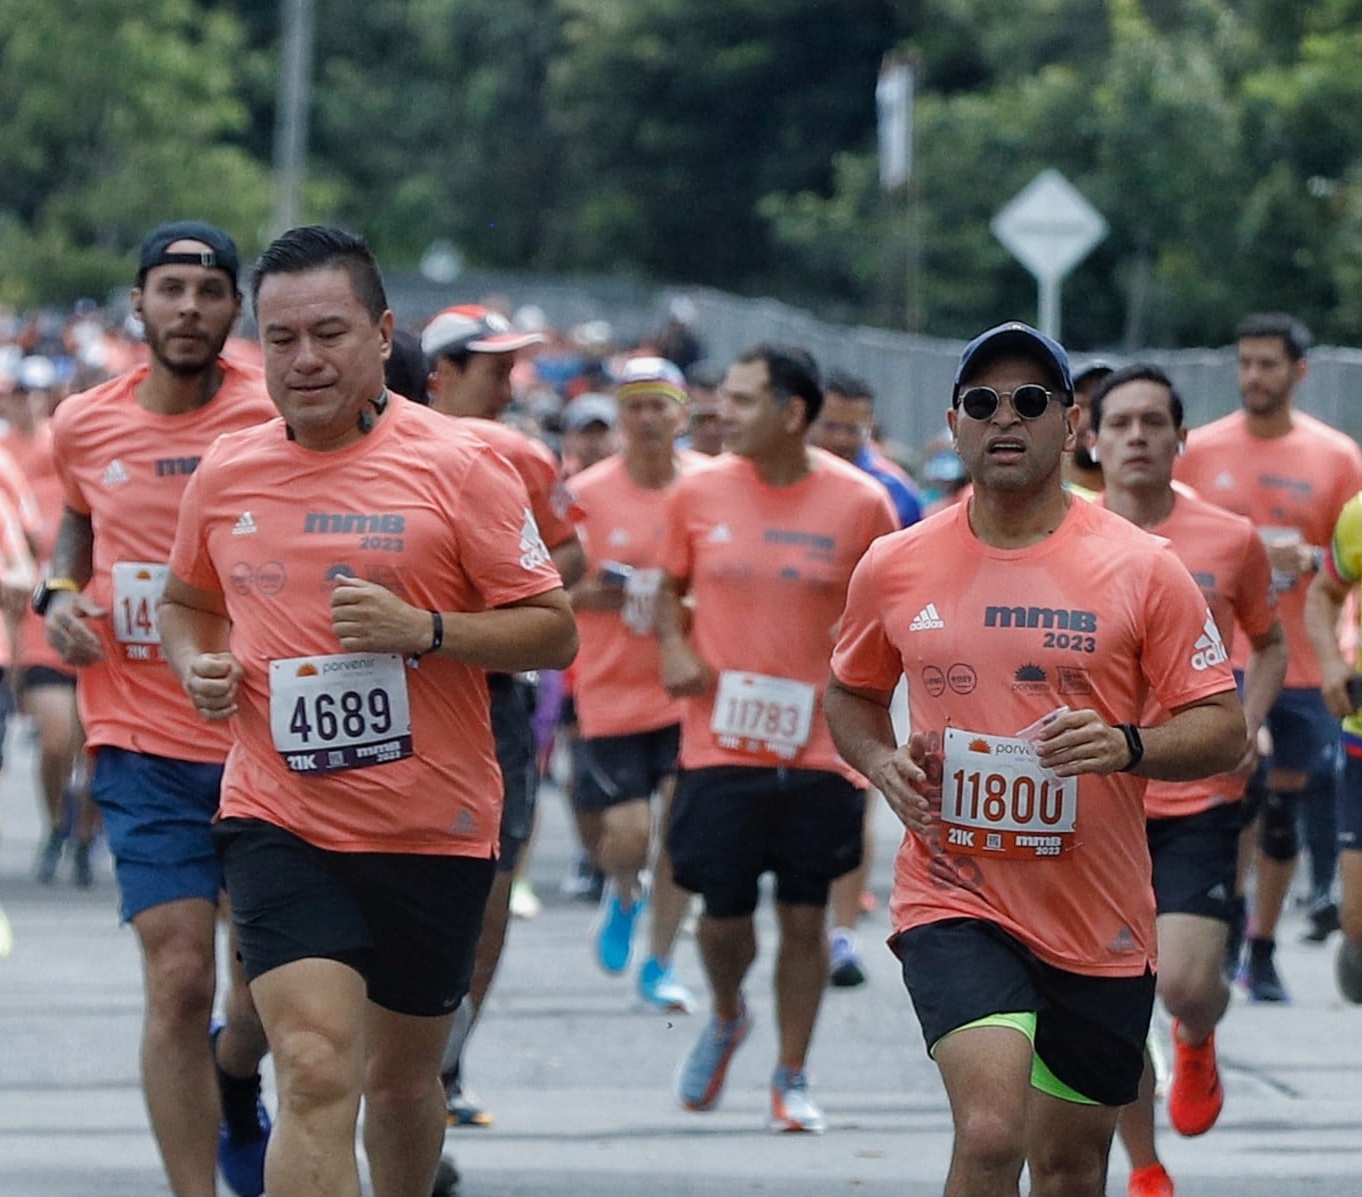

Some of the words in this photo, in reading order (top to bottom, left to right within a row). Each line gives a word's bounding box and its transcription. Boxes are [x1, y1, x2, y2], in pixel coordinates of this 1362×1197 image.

[305, 513, 405, 534] mmB
[360, 537, 404, 552] 2023
[122, 598, 161, 636] 14
[909, 619, 945, 631] adidas
[984, 606, 1097, 633] mmB
[1043, 633, 1097, 654] 2023
[322, 659, 376, 675] porvenir
[290, 688, 392, 743] 4689
[726, 697, 799, 737] 11783
[953, 769, 1064, 826] 11800
[948, 828, 975, 847] 21K
[1015, 835, 1062, 848] mmB
[1035, 846, 1061, 856] 2023
